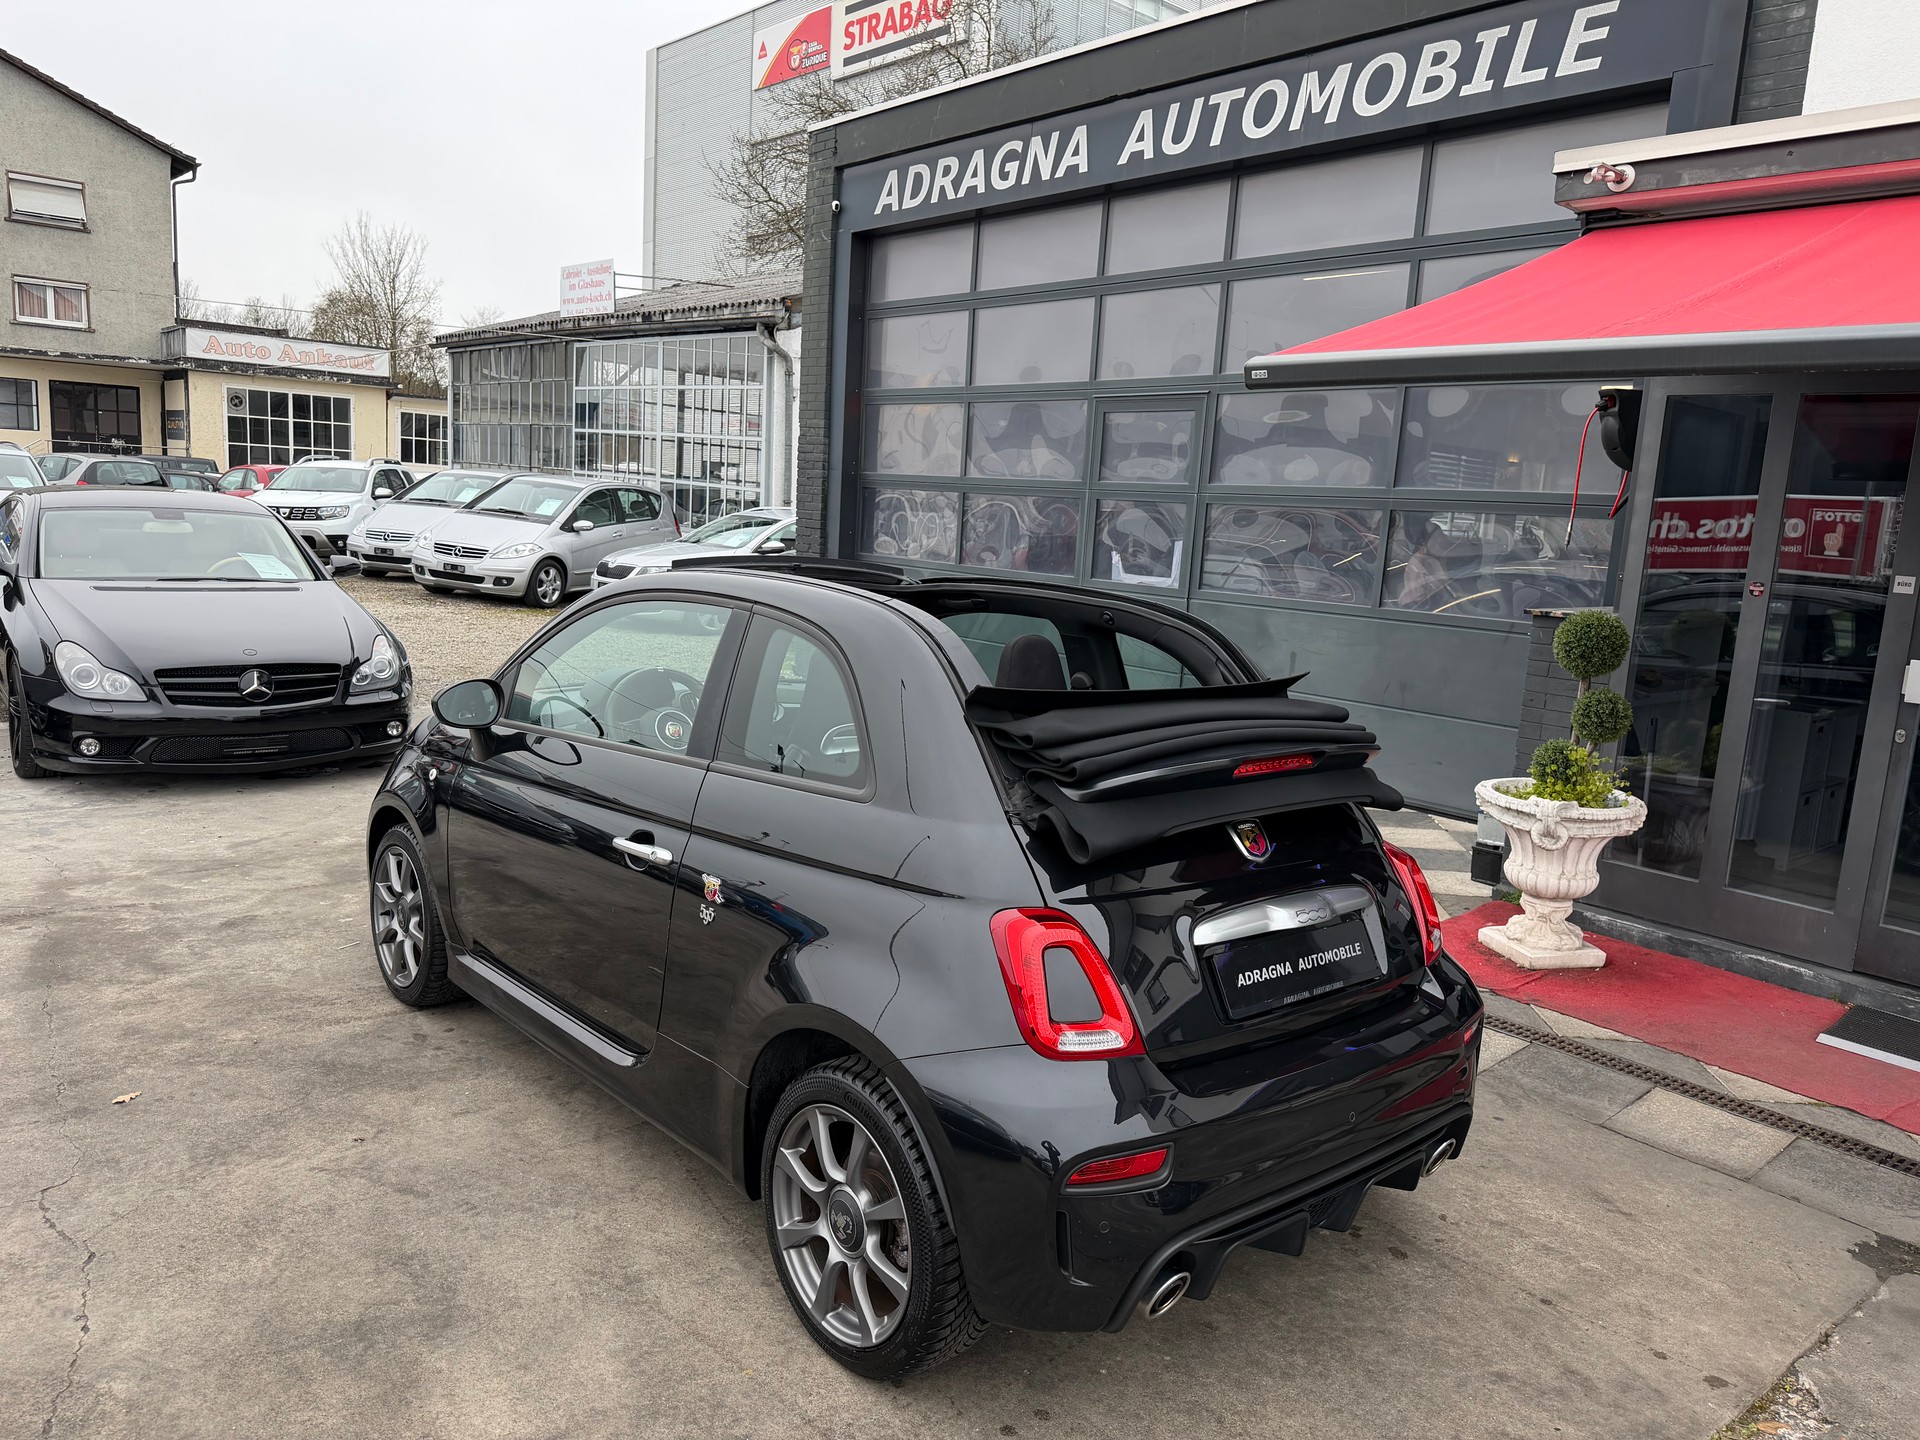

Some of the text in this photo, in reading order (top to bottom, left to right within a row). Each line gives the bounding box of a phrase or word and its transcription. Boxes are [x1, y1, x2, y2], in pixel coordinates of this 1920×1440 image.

[801, 51, 828, 68] ZURIQUE
[874, 0, 1620, 215] ADRAGNA AUTOMOBILE
[578, 278, 605, 289] Glashaus
[203, 335, 374, 371] Auto Ankauf
[1295, 907, 1328, 924] 500
[1237, 942, 1362, 988] ADRAGNA AUTOMOBILE
[843, 1090, 892, 1147] Continental
